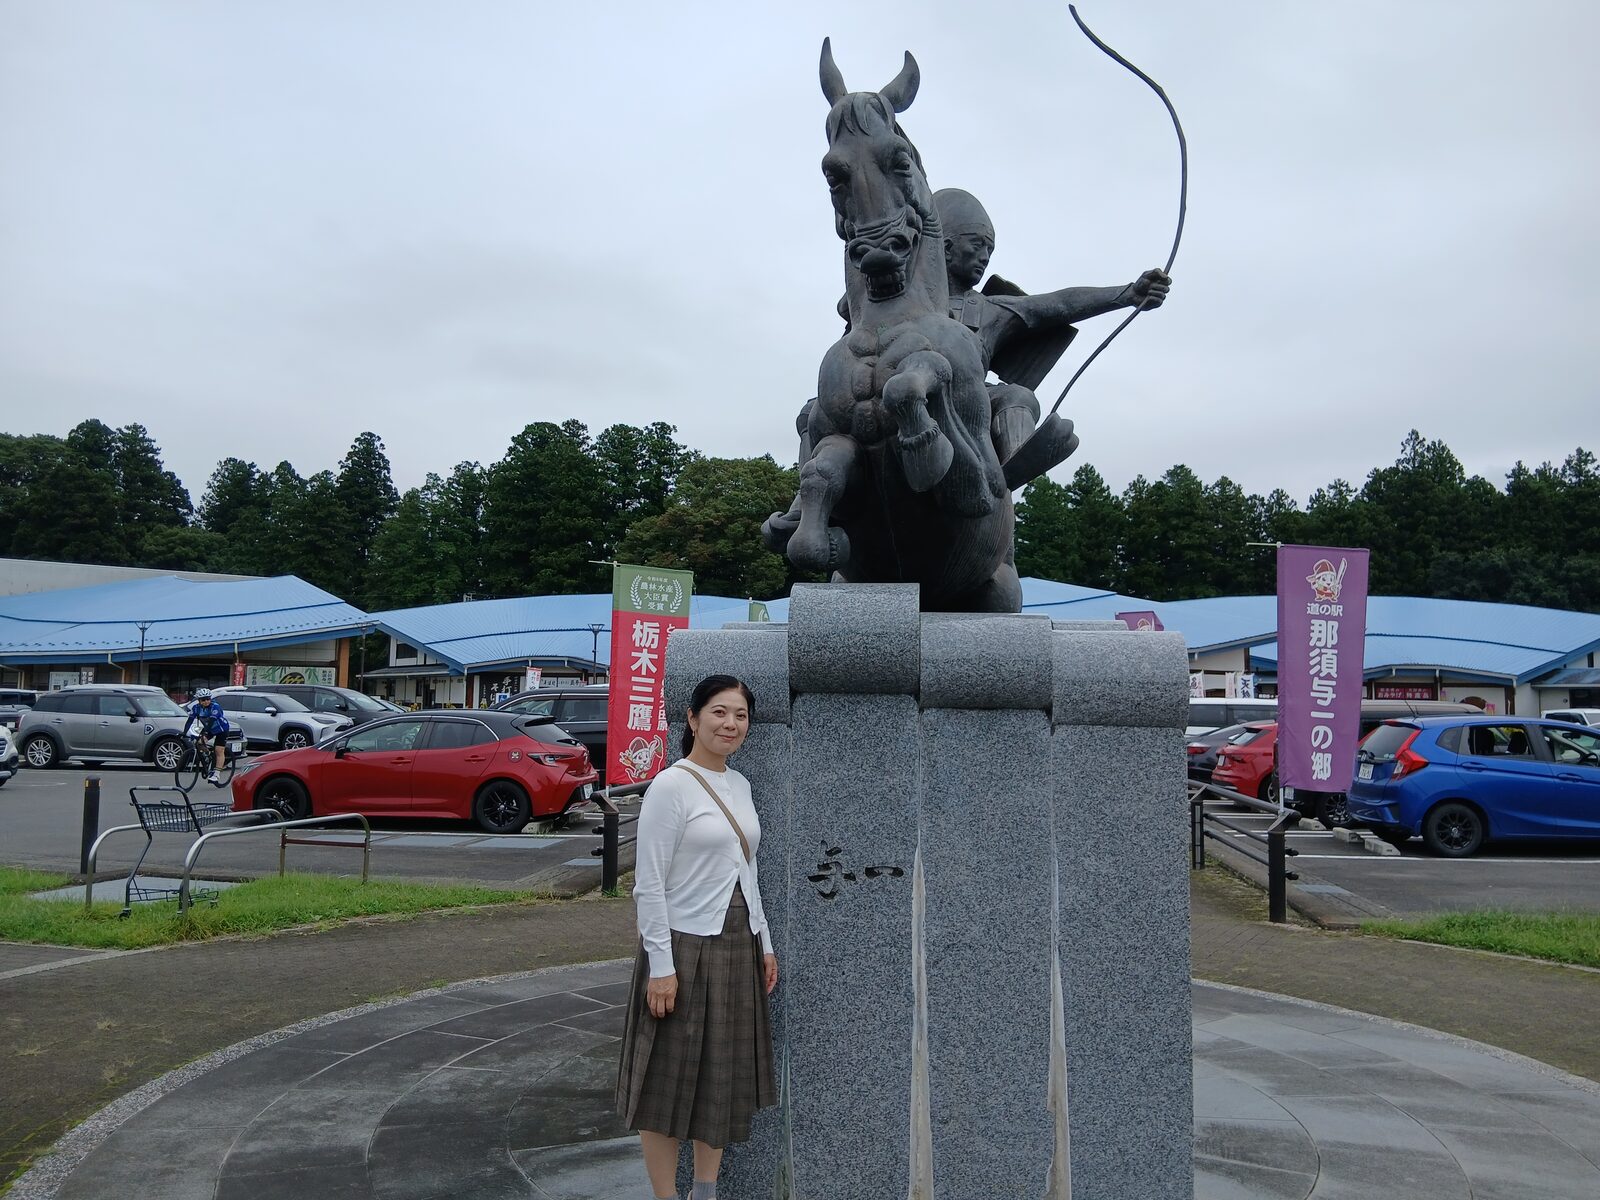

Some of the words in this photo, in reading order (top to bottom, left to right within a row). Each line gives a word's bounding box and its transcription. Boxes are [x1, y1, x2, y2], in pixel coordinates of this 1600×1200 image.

[644, 592, 669, 602] 大臣賞
[647, 601, 665, 611] 受賞
[1306, 602, 1343, 617] 道の駅
[627, 620, 660, 731] 栃木三鷹
[1309, 619, 1339, 781] 那須与一の郷
